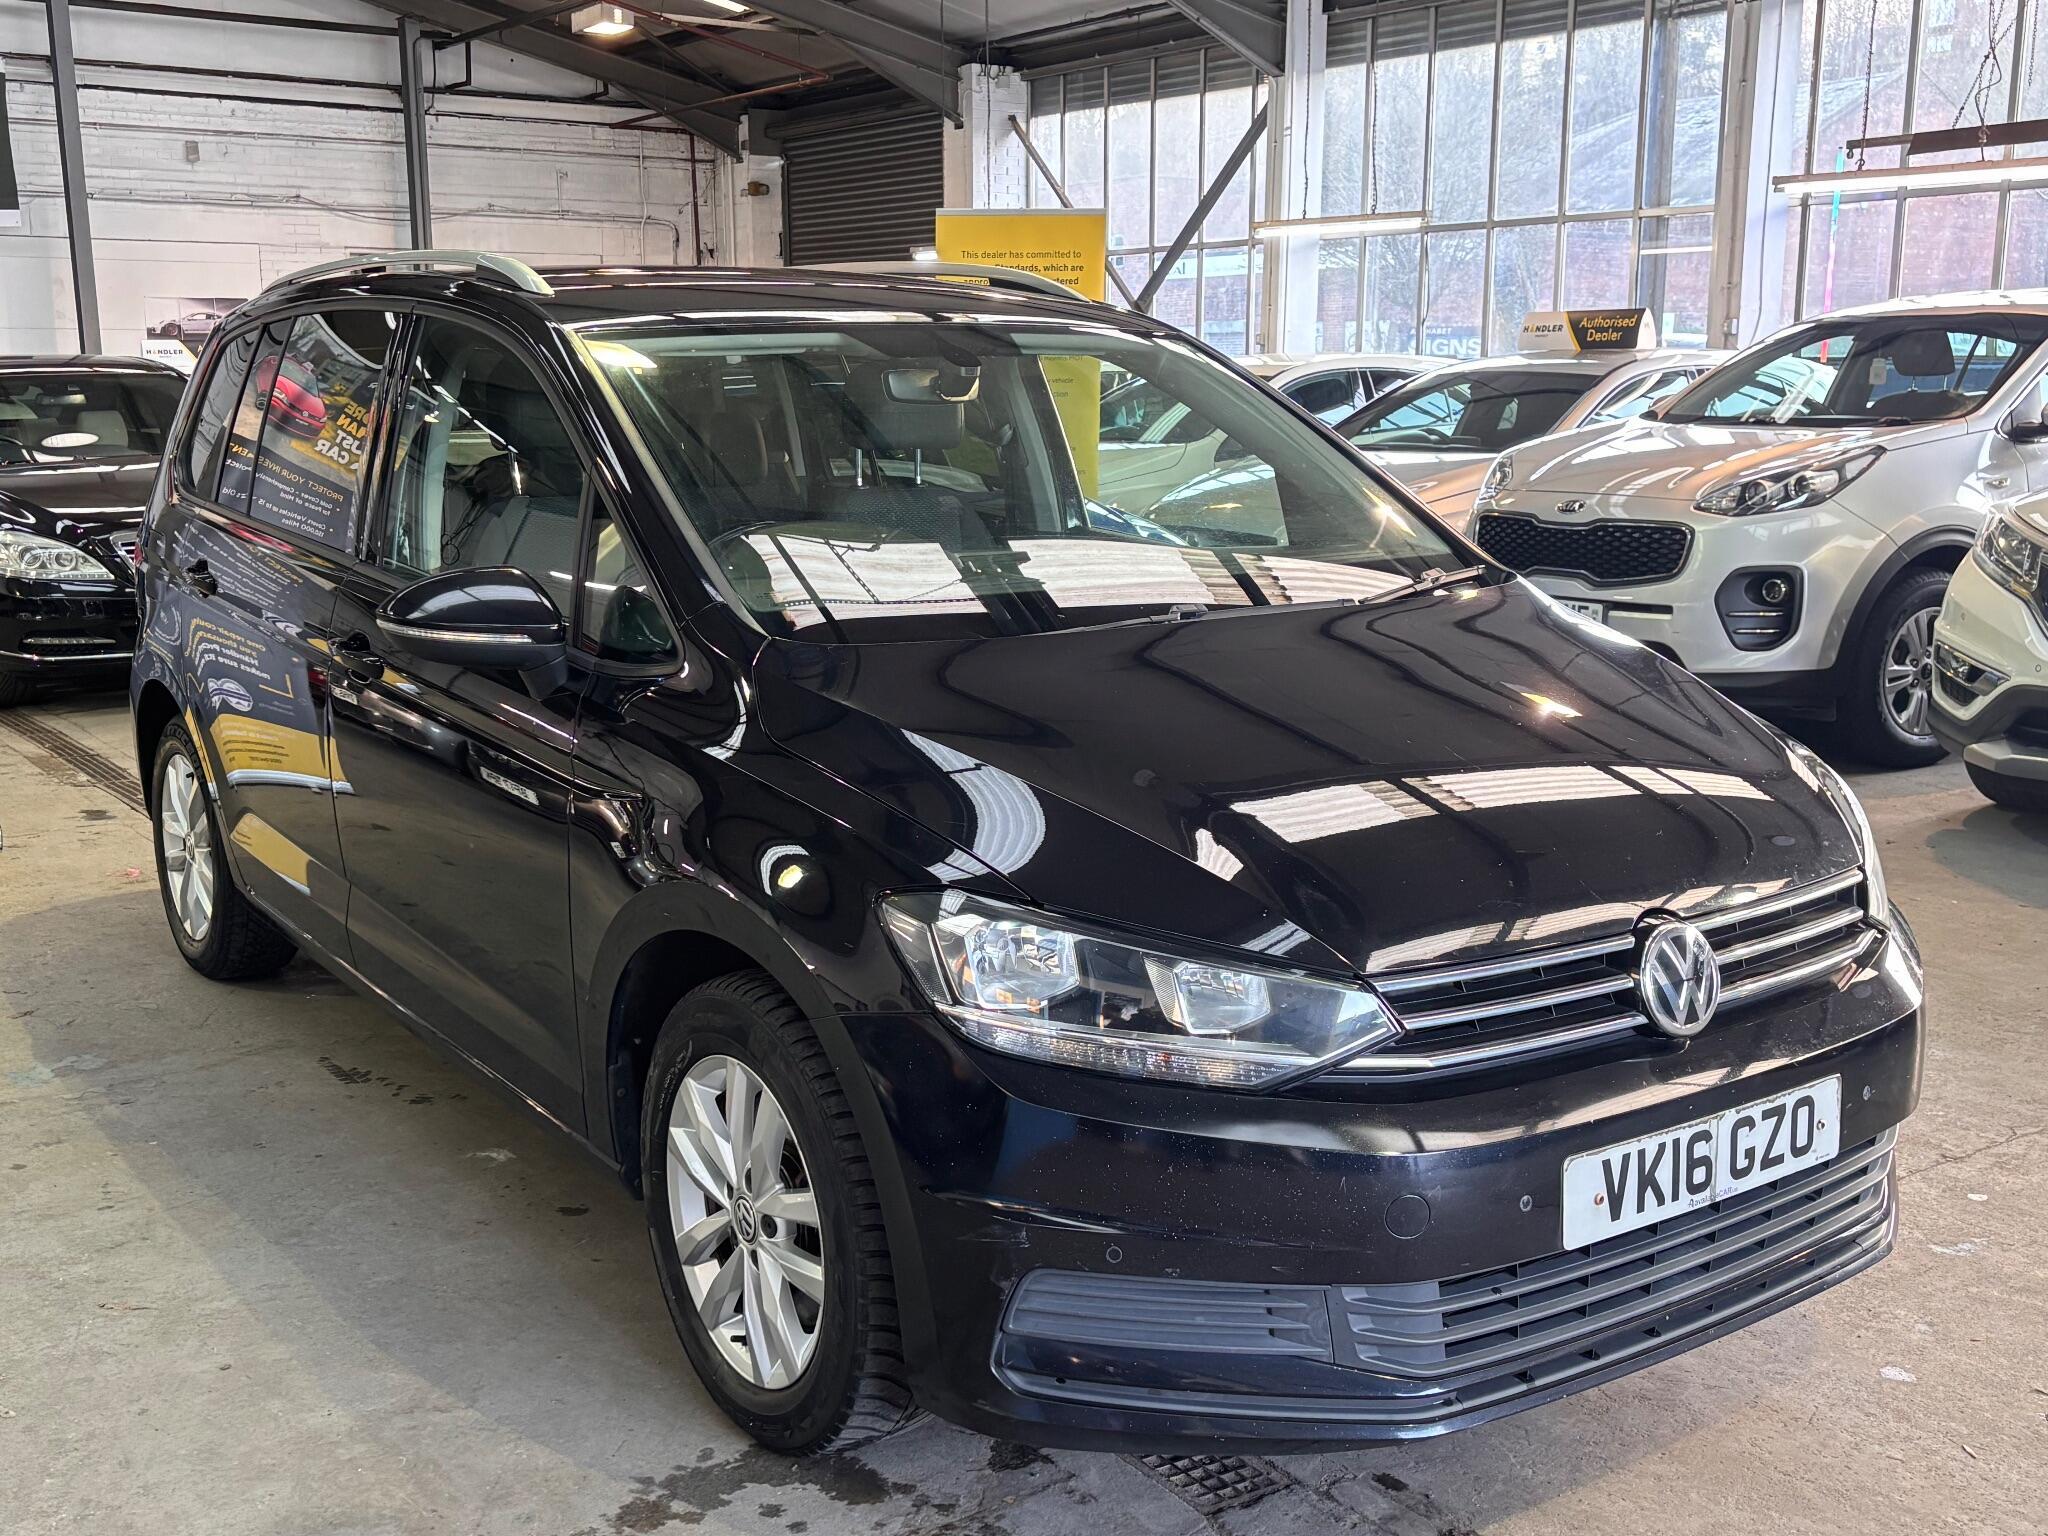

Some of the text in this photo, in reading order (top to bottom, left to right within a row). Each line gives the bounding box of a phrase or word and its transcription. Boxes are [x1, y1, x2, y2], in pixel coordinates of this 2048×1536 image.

[962, 250, 978, 259] This
[981, 250, 1007, 259] dealer
[1009, 250, 1024, 259] has
[1026, 250, 1071, 259] committed
[994, 263, 1042, 273] ndards,
[1044, 264, 1069, 272] which
[1055, 277, 1079, 286] tered
[1579, 315, 1638, 329] Authorised
[1409, 327, 1452, 335] AHABET
[1587, 329, 1623, 342] Dealer
[1601, 1095, 1816, 1222] VK16 GZO
